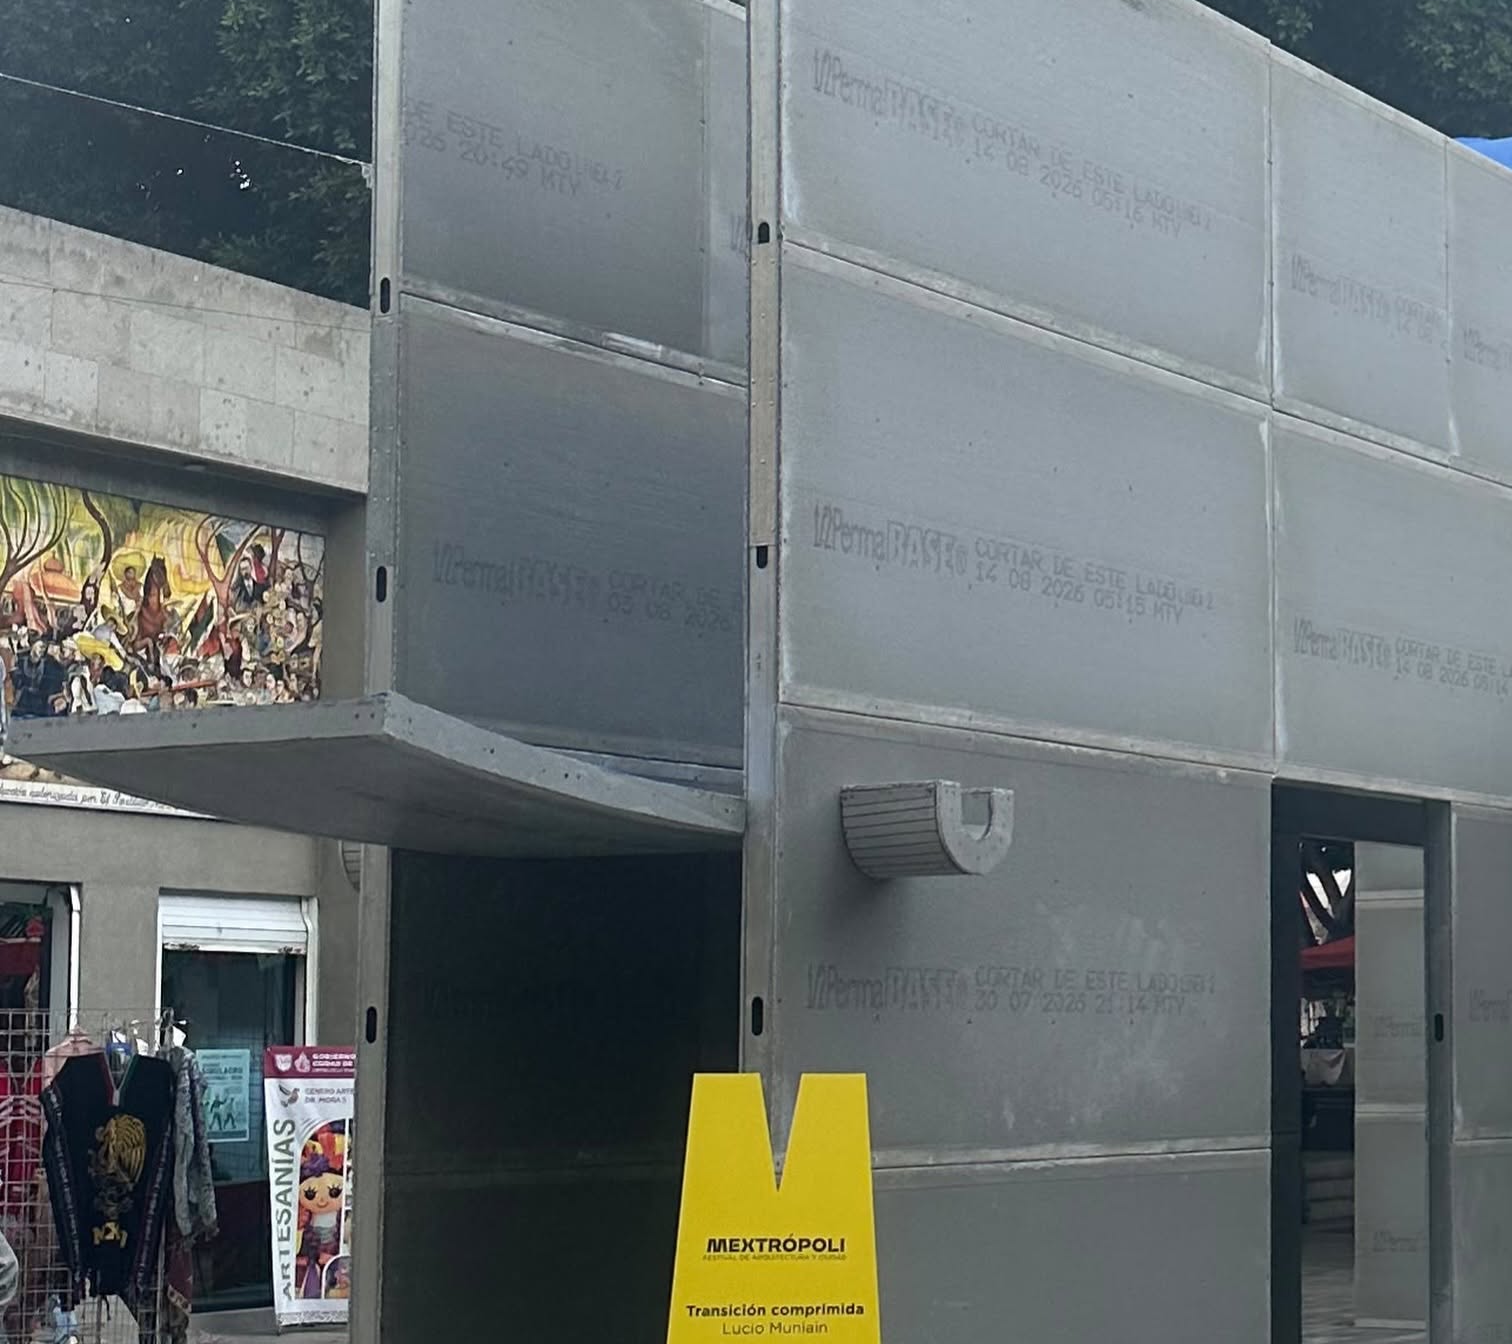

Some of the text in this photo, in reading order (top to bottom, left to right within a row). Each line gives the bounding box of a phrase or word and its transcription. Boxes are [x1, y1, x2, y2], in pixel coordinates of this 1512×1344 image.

[447, 110, 503, 149] ESTE
[1084, 560, 1128, 590] ESTE
[1041, 574, 1086, 604] 2026
[1085, 968, 1128, 992] ESTE
[271, 1119, 296, 1301] ARTESANÍAS
[707, 1233, 845, 1253] MEXTRÓPOLI
[687, 1304, 864, 1318] Transición comprimida
[722, 1321, 828, 1335] Lucio Muniain
